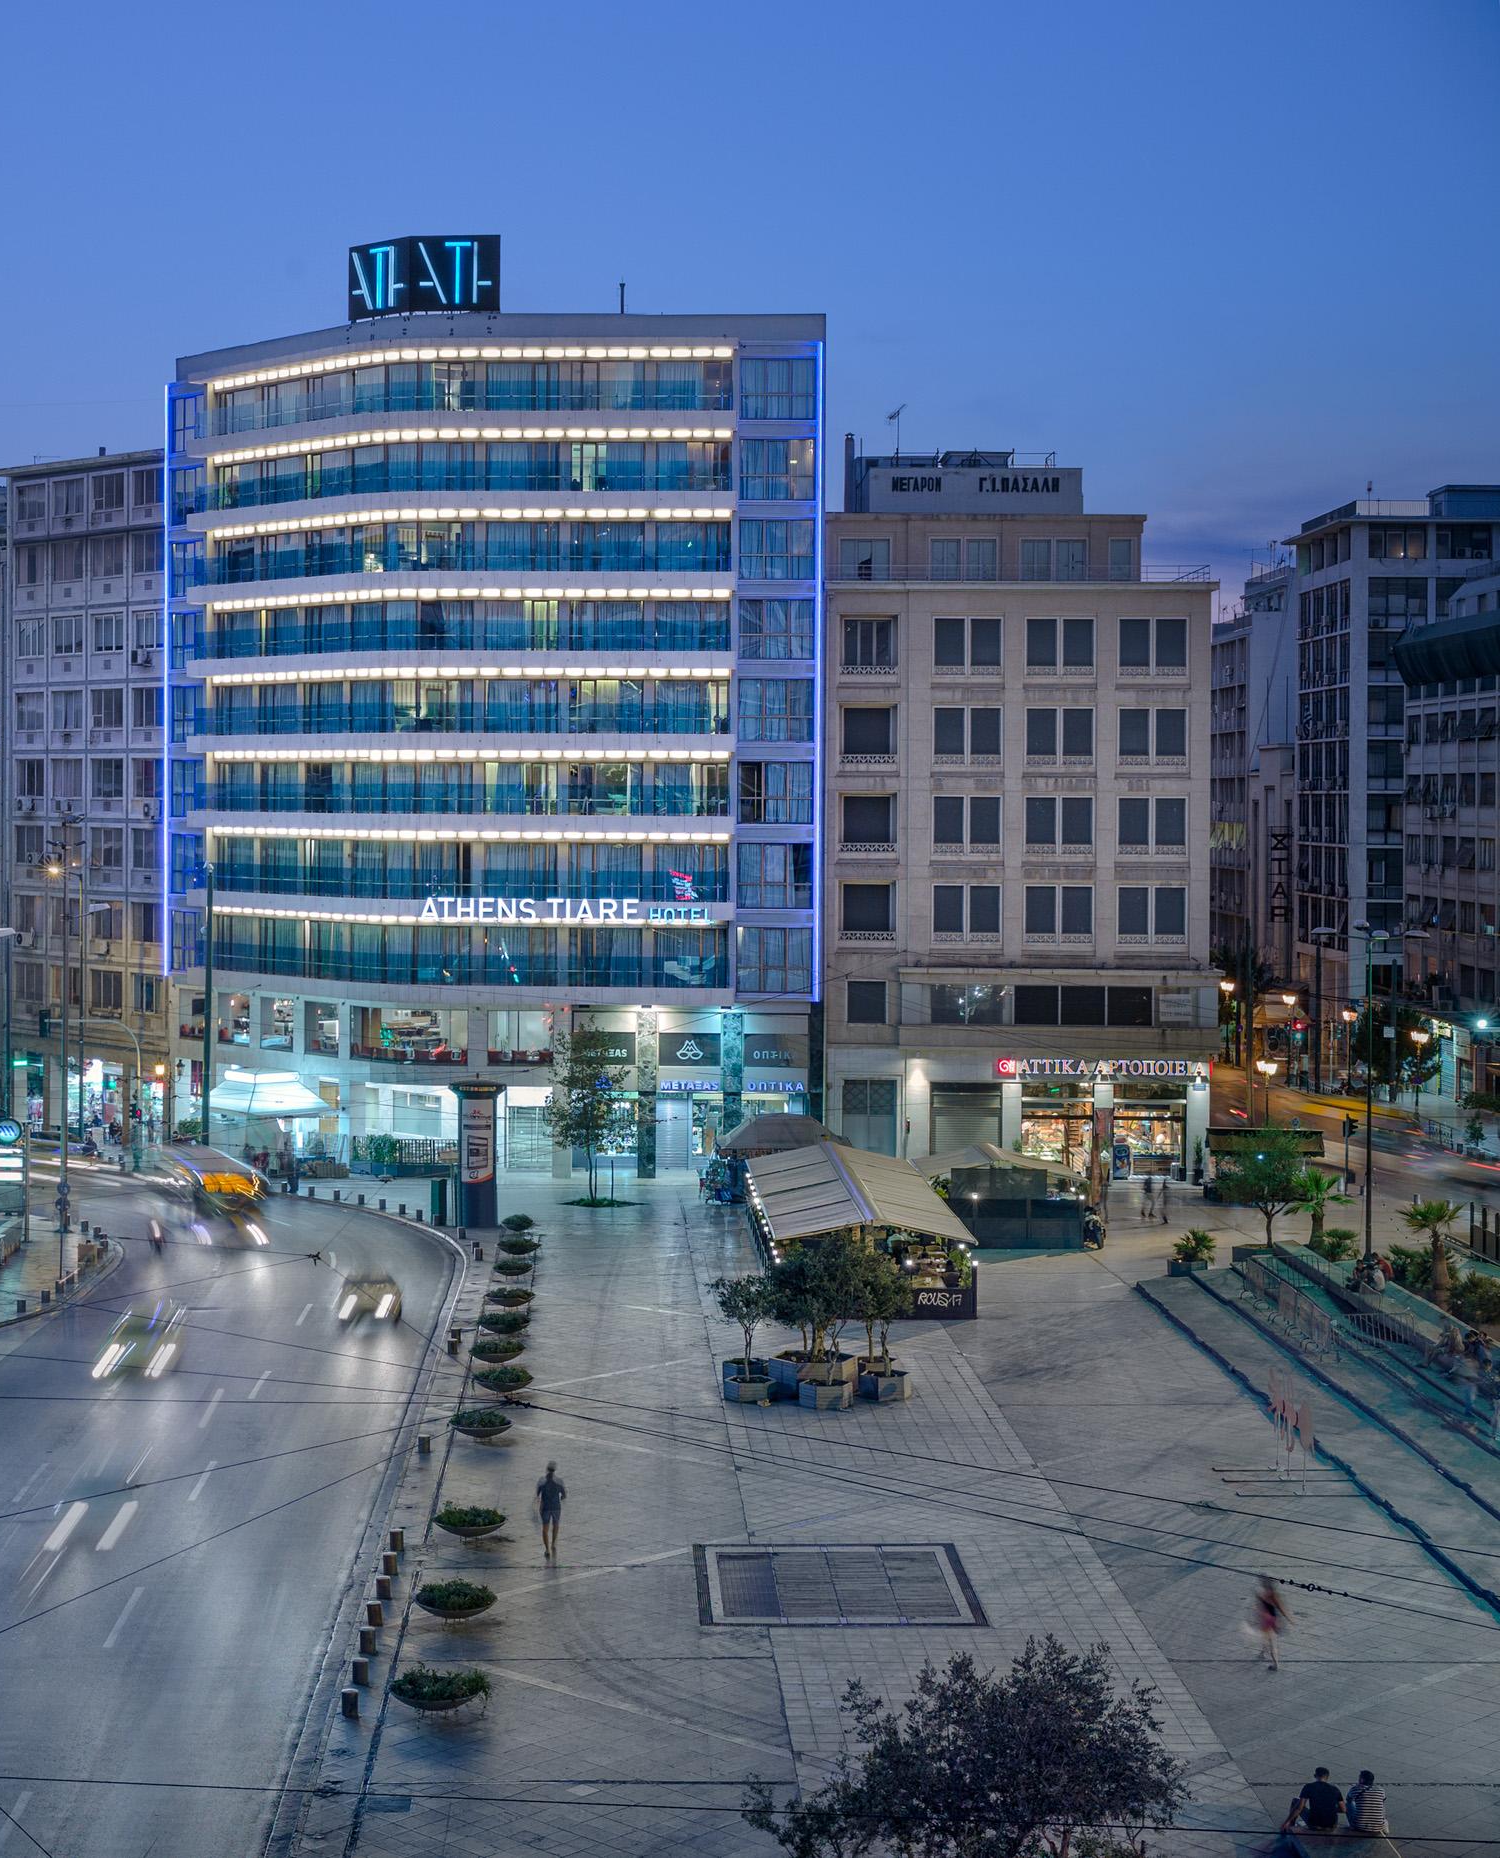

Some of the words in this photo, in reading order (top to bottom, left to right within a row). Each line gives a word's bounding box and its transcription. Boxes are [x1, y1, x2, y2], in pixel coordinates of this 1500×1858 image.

[892, 476, 942, 492] ΜΕΓΑΡΟΝ
[421, 896, 537, 922] ATHENS
[547, 898, 639, 921] TIARE
[650, 907, 712, 924] HOTEL
[1019, 1059, 1088, 1075] ΑΤΤΙΚΑ
[1094, 1060, 1206, 1077] ΑΡΤΟΠΟΙΕΙΑ
[747, 1081, 804, 1092] ΟΠΤΙΚΑ
